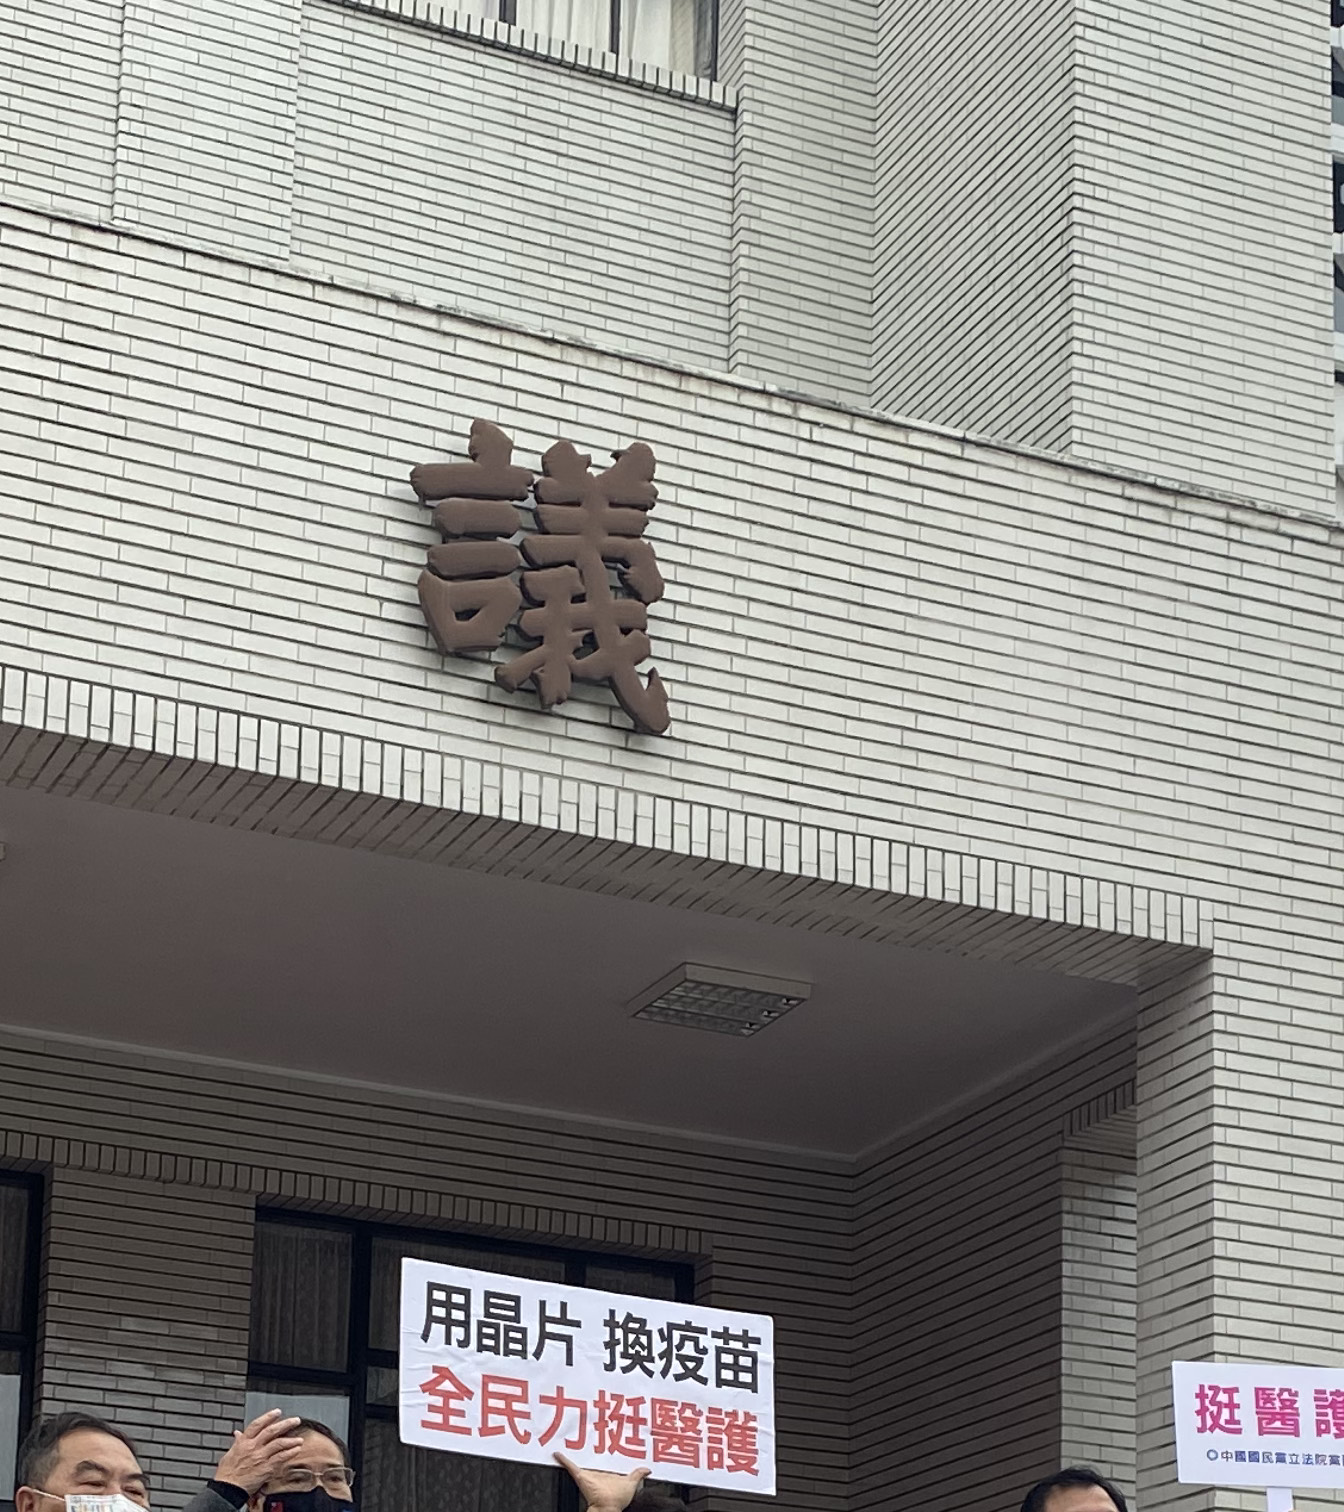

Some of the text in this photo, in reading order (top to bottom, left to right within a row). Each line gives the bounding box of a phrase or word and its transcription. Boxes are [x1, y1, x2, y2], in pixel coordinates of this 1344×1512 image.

[410, 418, 672, 735] 議
[421, 1282, 761, 1394] 用晶片 換疫苗
[420, 1366, 760, 1477] 全民力挺醫護
